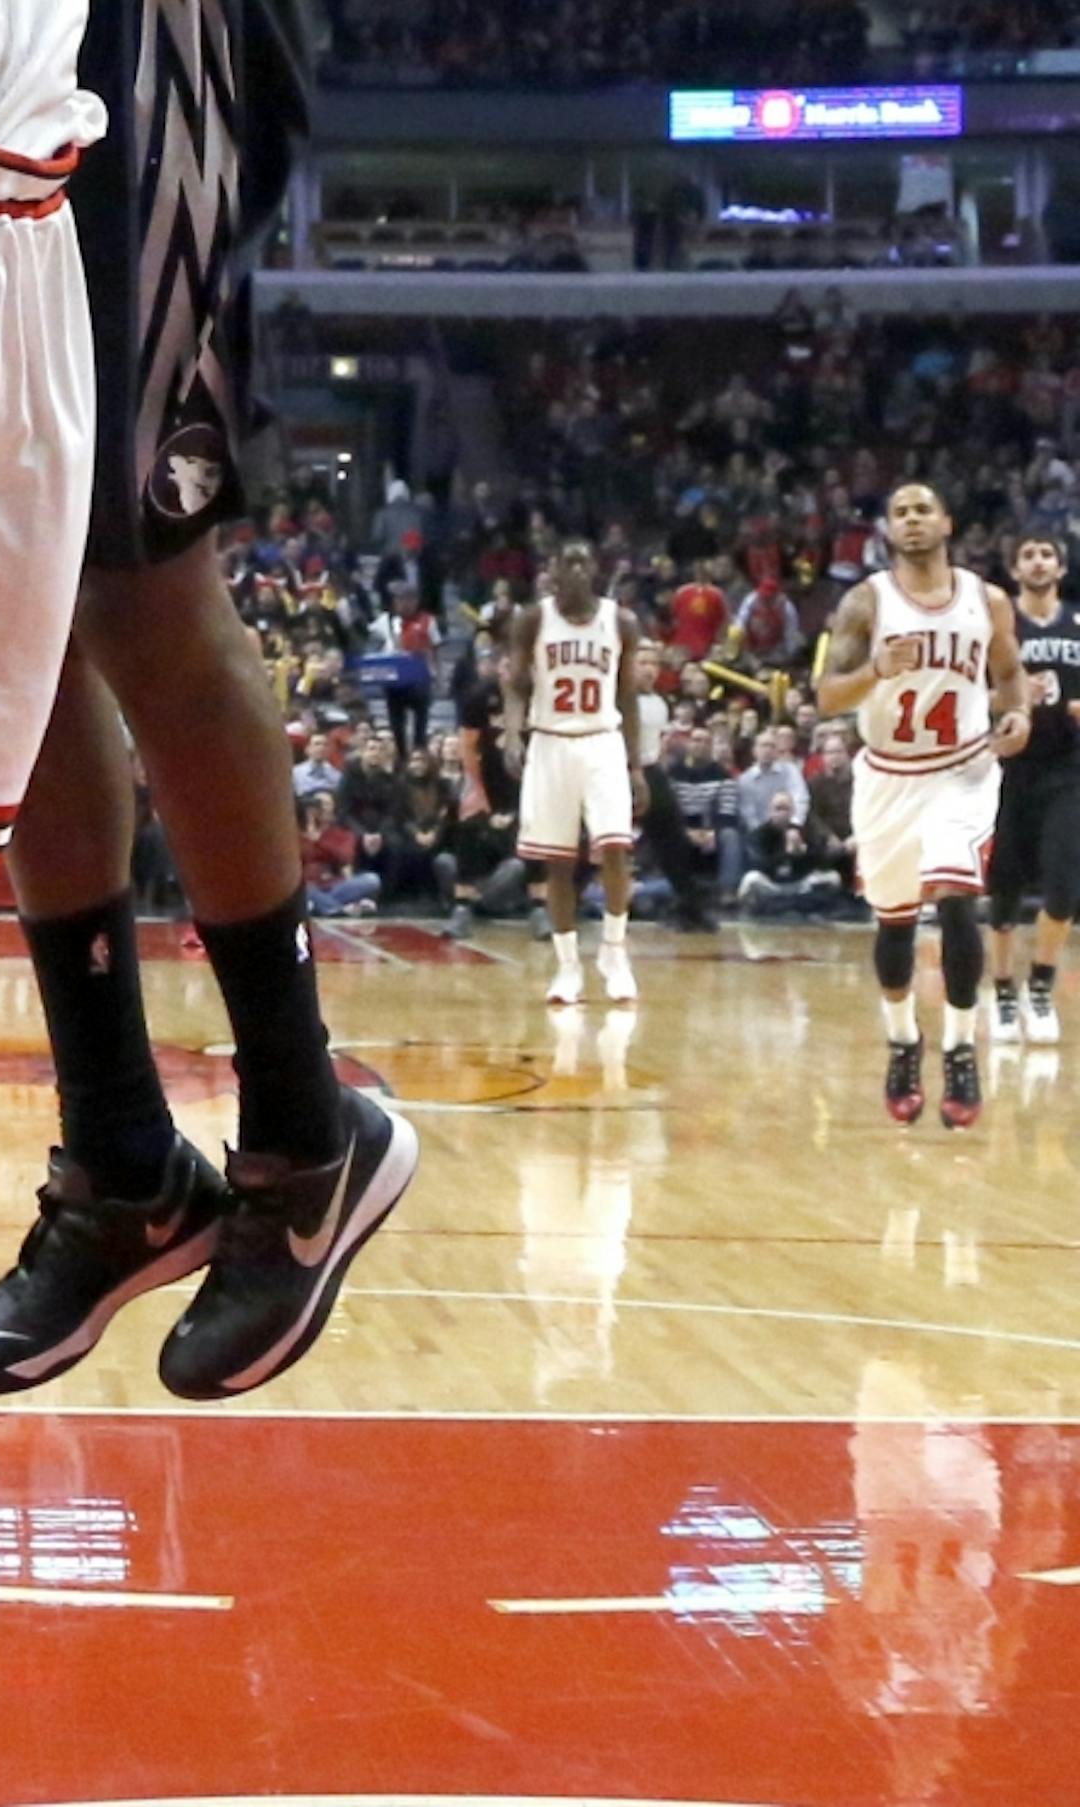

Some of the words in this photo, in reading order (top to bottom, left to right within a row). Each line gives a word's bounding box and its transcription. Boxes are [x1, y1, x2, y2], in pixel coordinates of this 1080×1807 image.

[546, 639, 611, 675] BULLS
[553, 677, 601, 713] 20
[893, 689, 958, 746] 14
